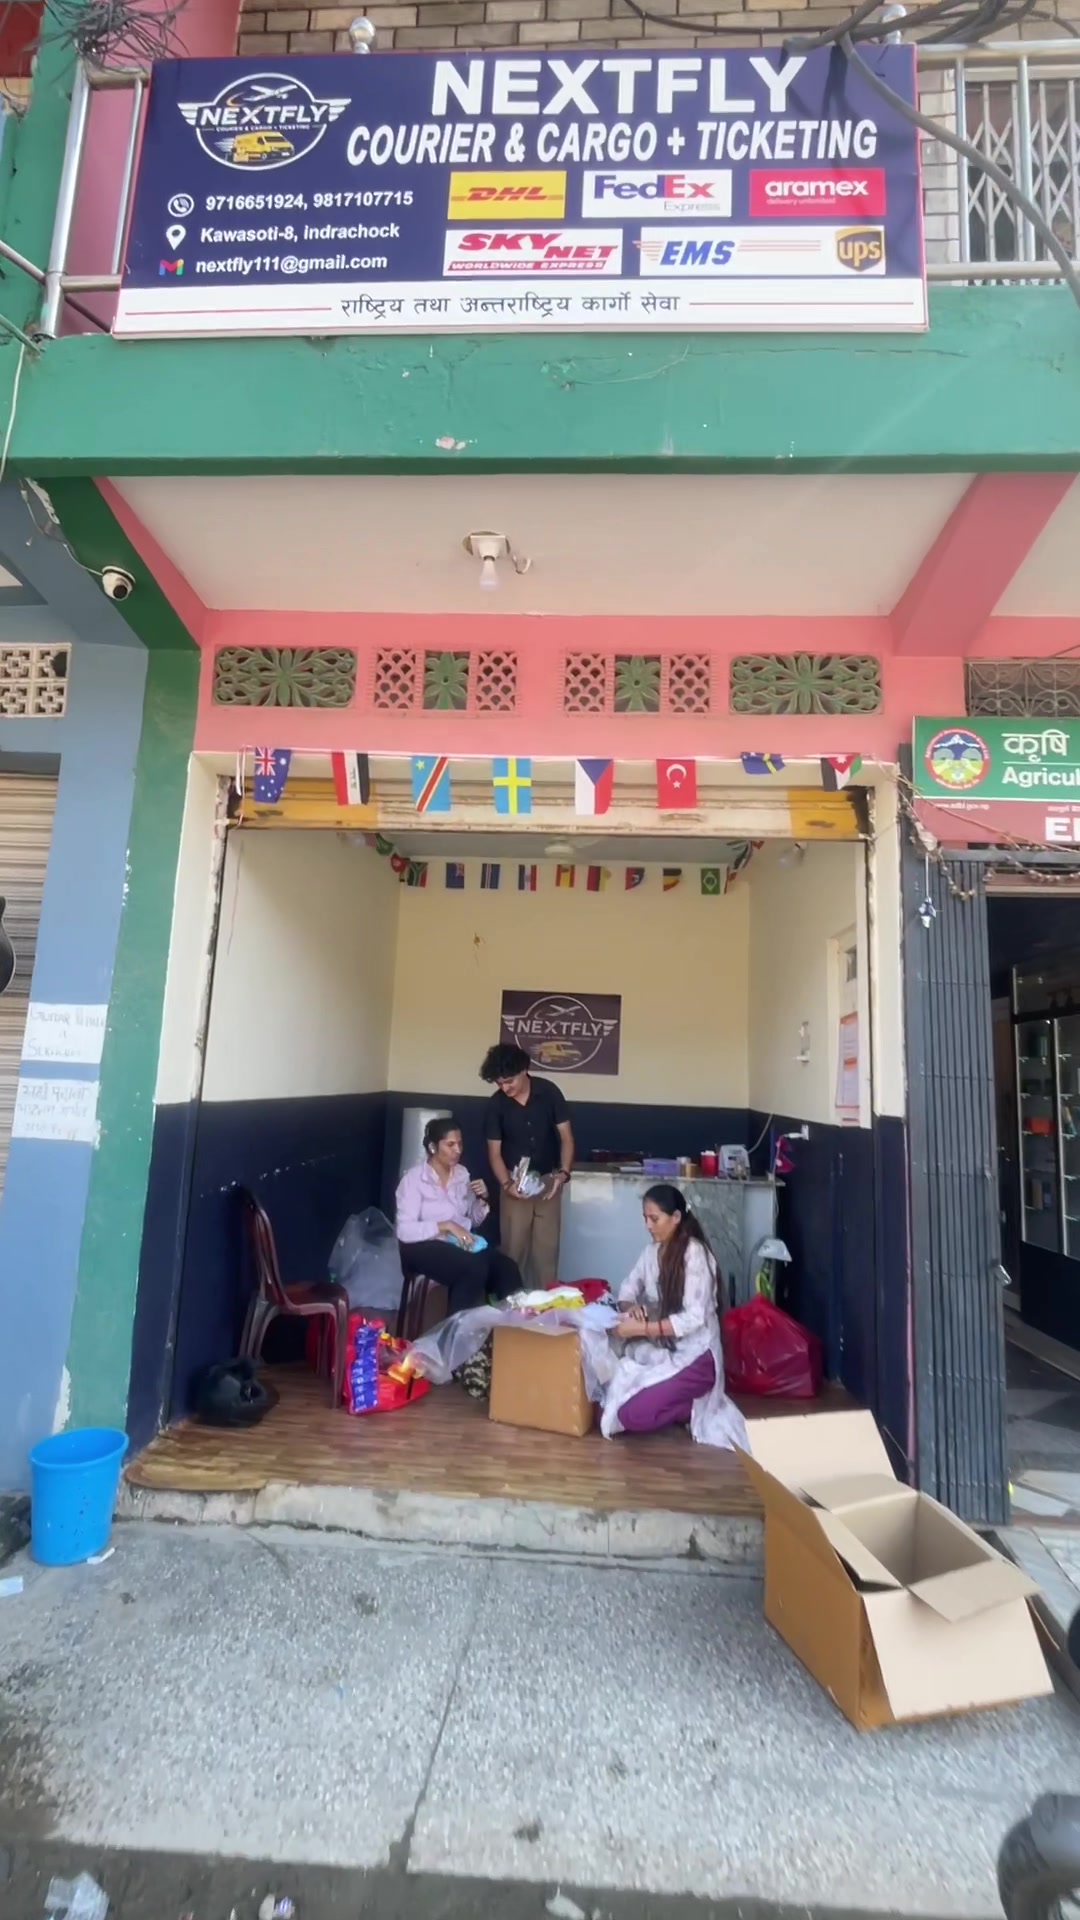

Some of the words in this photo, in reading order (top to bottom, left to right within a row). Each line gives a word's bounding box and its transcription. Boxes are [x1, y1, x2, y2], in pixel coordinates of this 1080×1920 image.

[432, 56, 807, 116] NEXTFLY
[200, 105, 328, 126] NEXTFLY
[347, 123, 496, 166] COURIER
[504, 122, 526, 164] &
[537, 121, 658, 163] CARGO
[697, 119, 878, 161] TICKETING
[467, 187, 548, 201] DHL
[594, 174, 716, 200] FedEx
[765, 180, 869, 197] aramex
[205, 193, 308, 211] 9716651924,
[313, 191, 414, 208] 9817107715
[664, 200, 721, 212] Express
[200, 226, 299, 243] Kawasoti-8,
[303, 223, 400, 241] indrachock
[660, 240, 736, 266] EMS
[838, 240, 882, 267] ups
[196, 254, 388, 275] nextfly111@gmail.com
[451, 262, 535, 270] WORLDWIDE
[540, 261, 604, 269] EXPRESS
[413, 298, 451, 313] तथा
[581, 292, 632, 312] कार्गो
[641, 292, 681, 314] सेवा
[1001, 729, 1070, 763] कृषि
[517, 1019, 602, 1037] NEXTFLY
